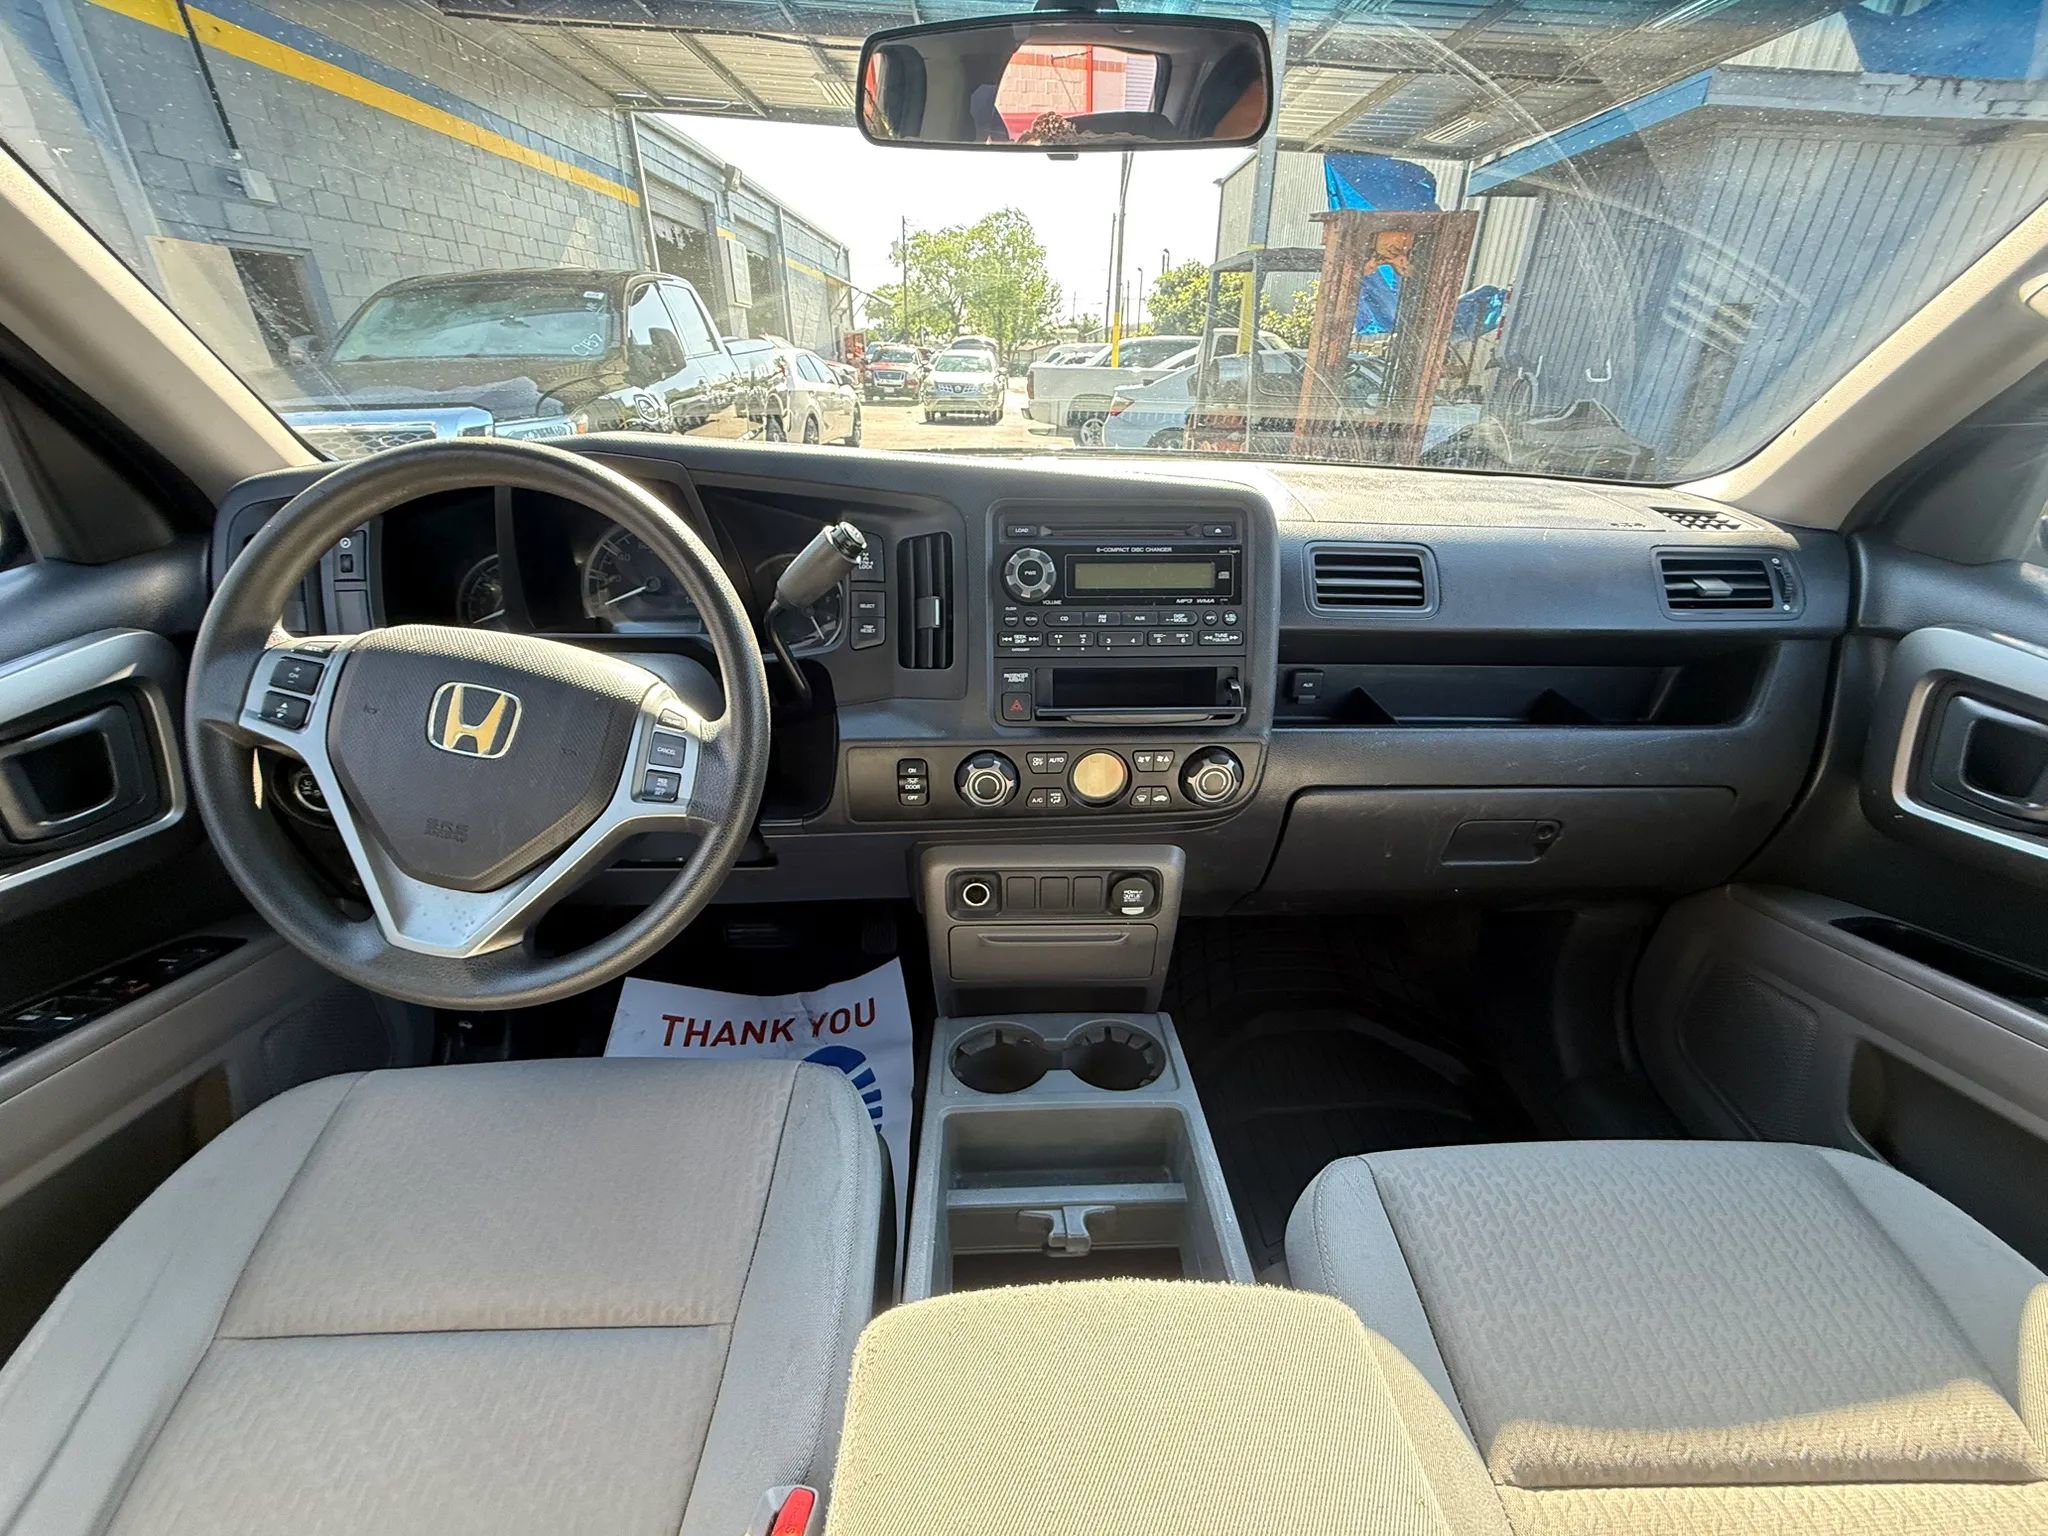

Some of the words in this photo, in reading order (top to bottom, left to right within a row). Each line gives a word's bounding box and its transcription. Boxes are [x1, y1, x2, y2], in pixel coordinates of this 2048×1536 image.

[657, 746, 676, 755] CANCEL
[905, 783, 921, 791] DOOR
[662, 1014, 796, 1048] THANK
[810, 997, 877, 1038] YOU
